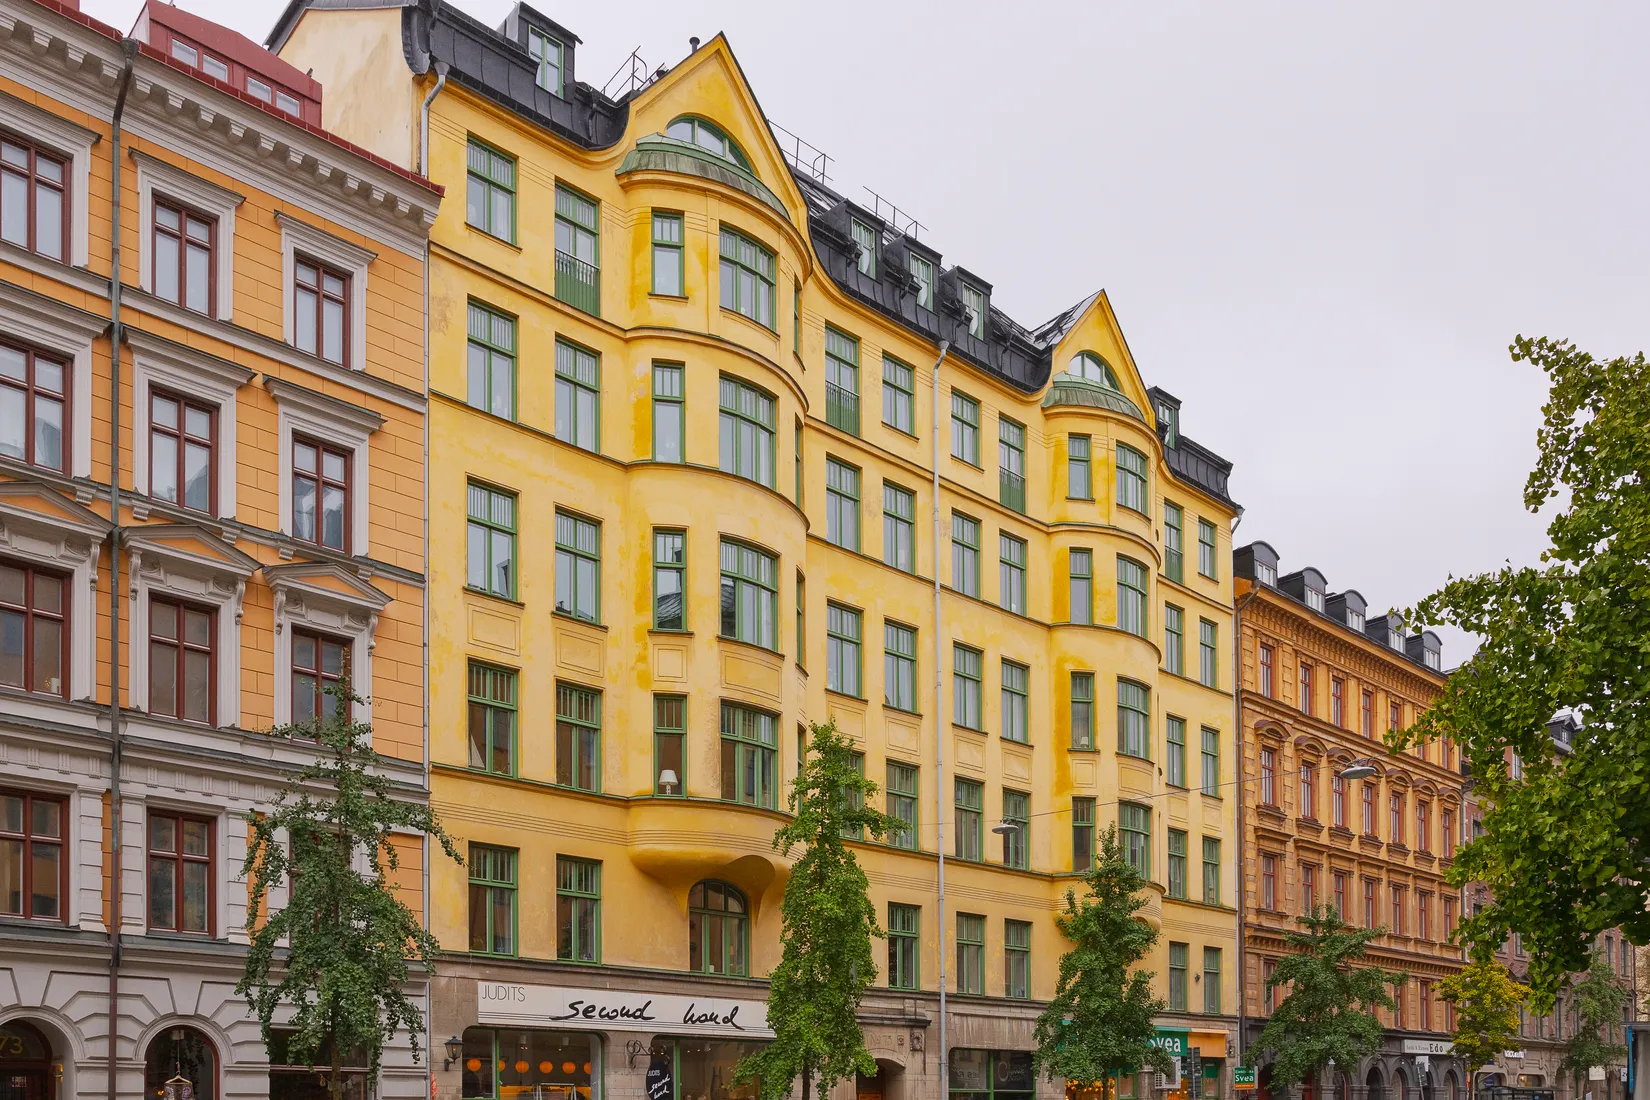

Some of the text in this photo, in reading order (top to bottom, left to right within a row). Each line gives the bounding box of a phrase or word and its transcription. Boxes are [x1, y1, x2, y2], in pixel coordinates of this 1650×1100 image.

[482, 984, 526, 1003] JUDITS
[683, 1003, 745, 1031] hand
[1429, 1043, 1444, 1053] Edo
